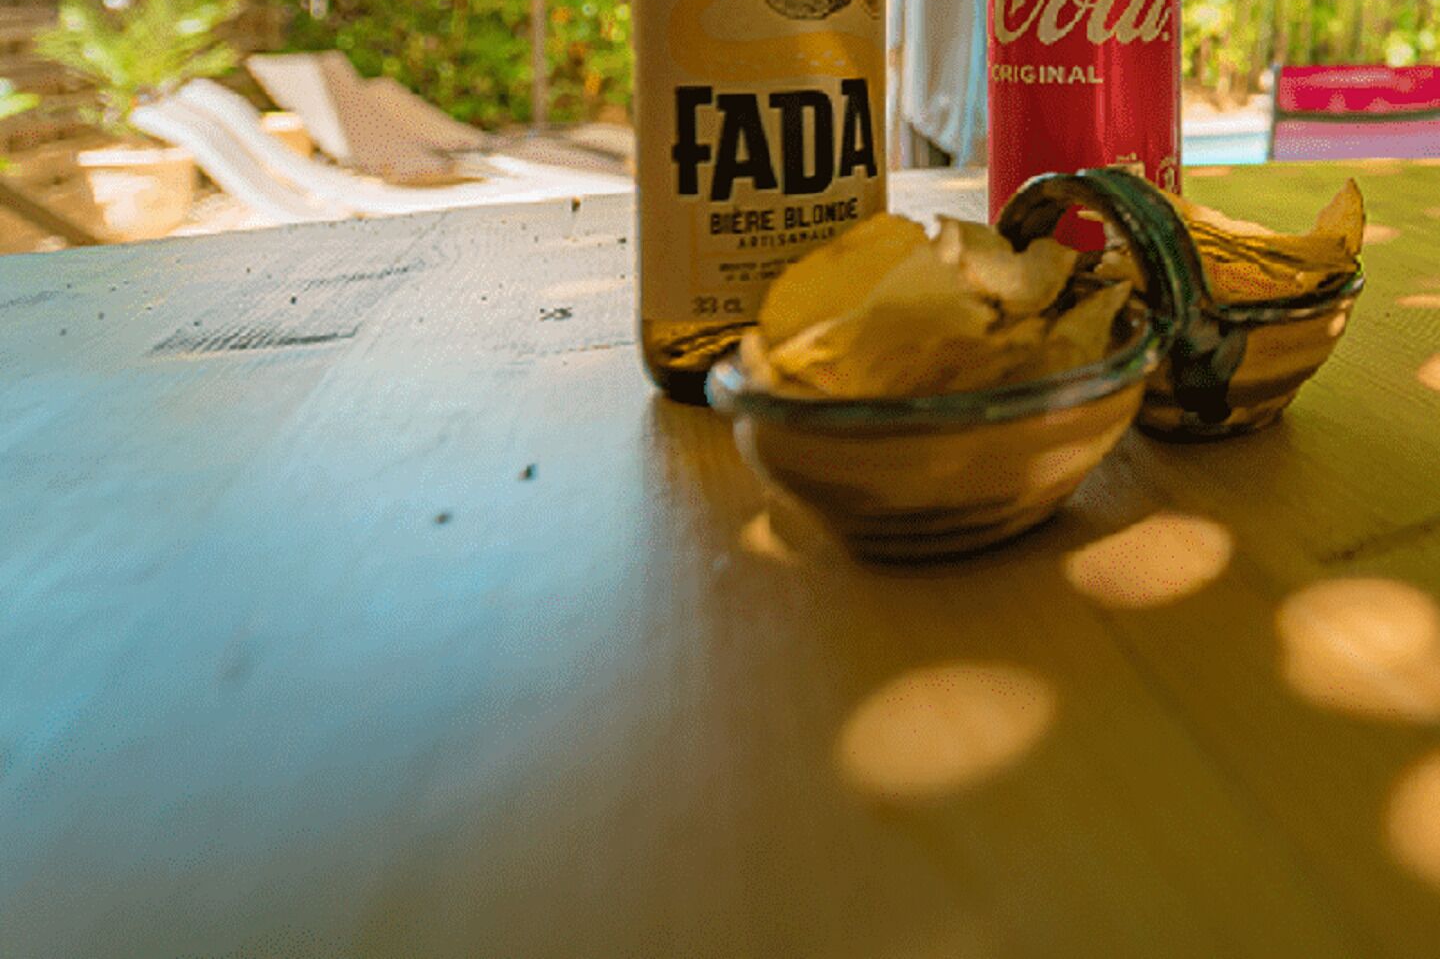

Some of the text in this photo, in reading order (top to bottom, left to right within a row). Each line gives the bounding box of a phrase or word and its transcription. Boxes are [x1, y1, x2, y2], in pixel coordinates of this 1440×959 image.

[991, 64, 1104, 84] ORIGINAL
[673, 78, 878, 201] FADA
[710, 197, 858, 235] BIÈRE BLONDE
